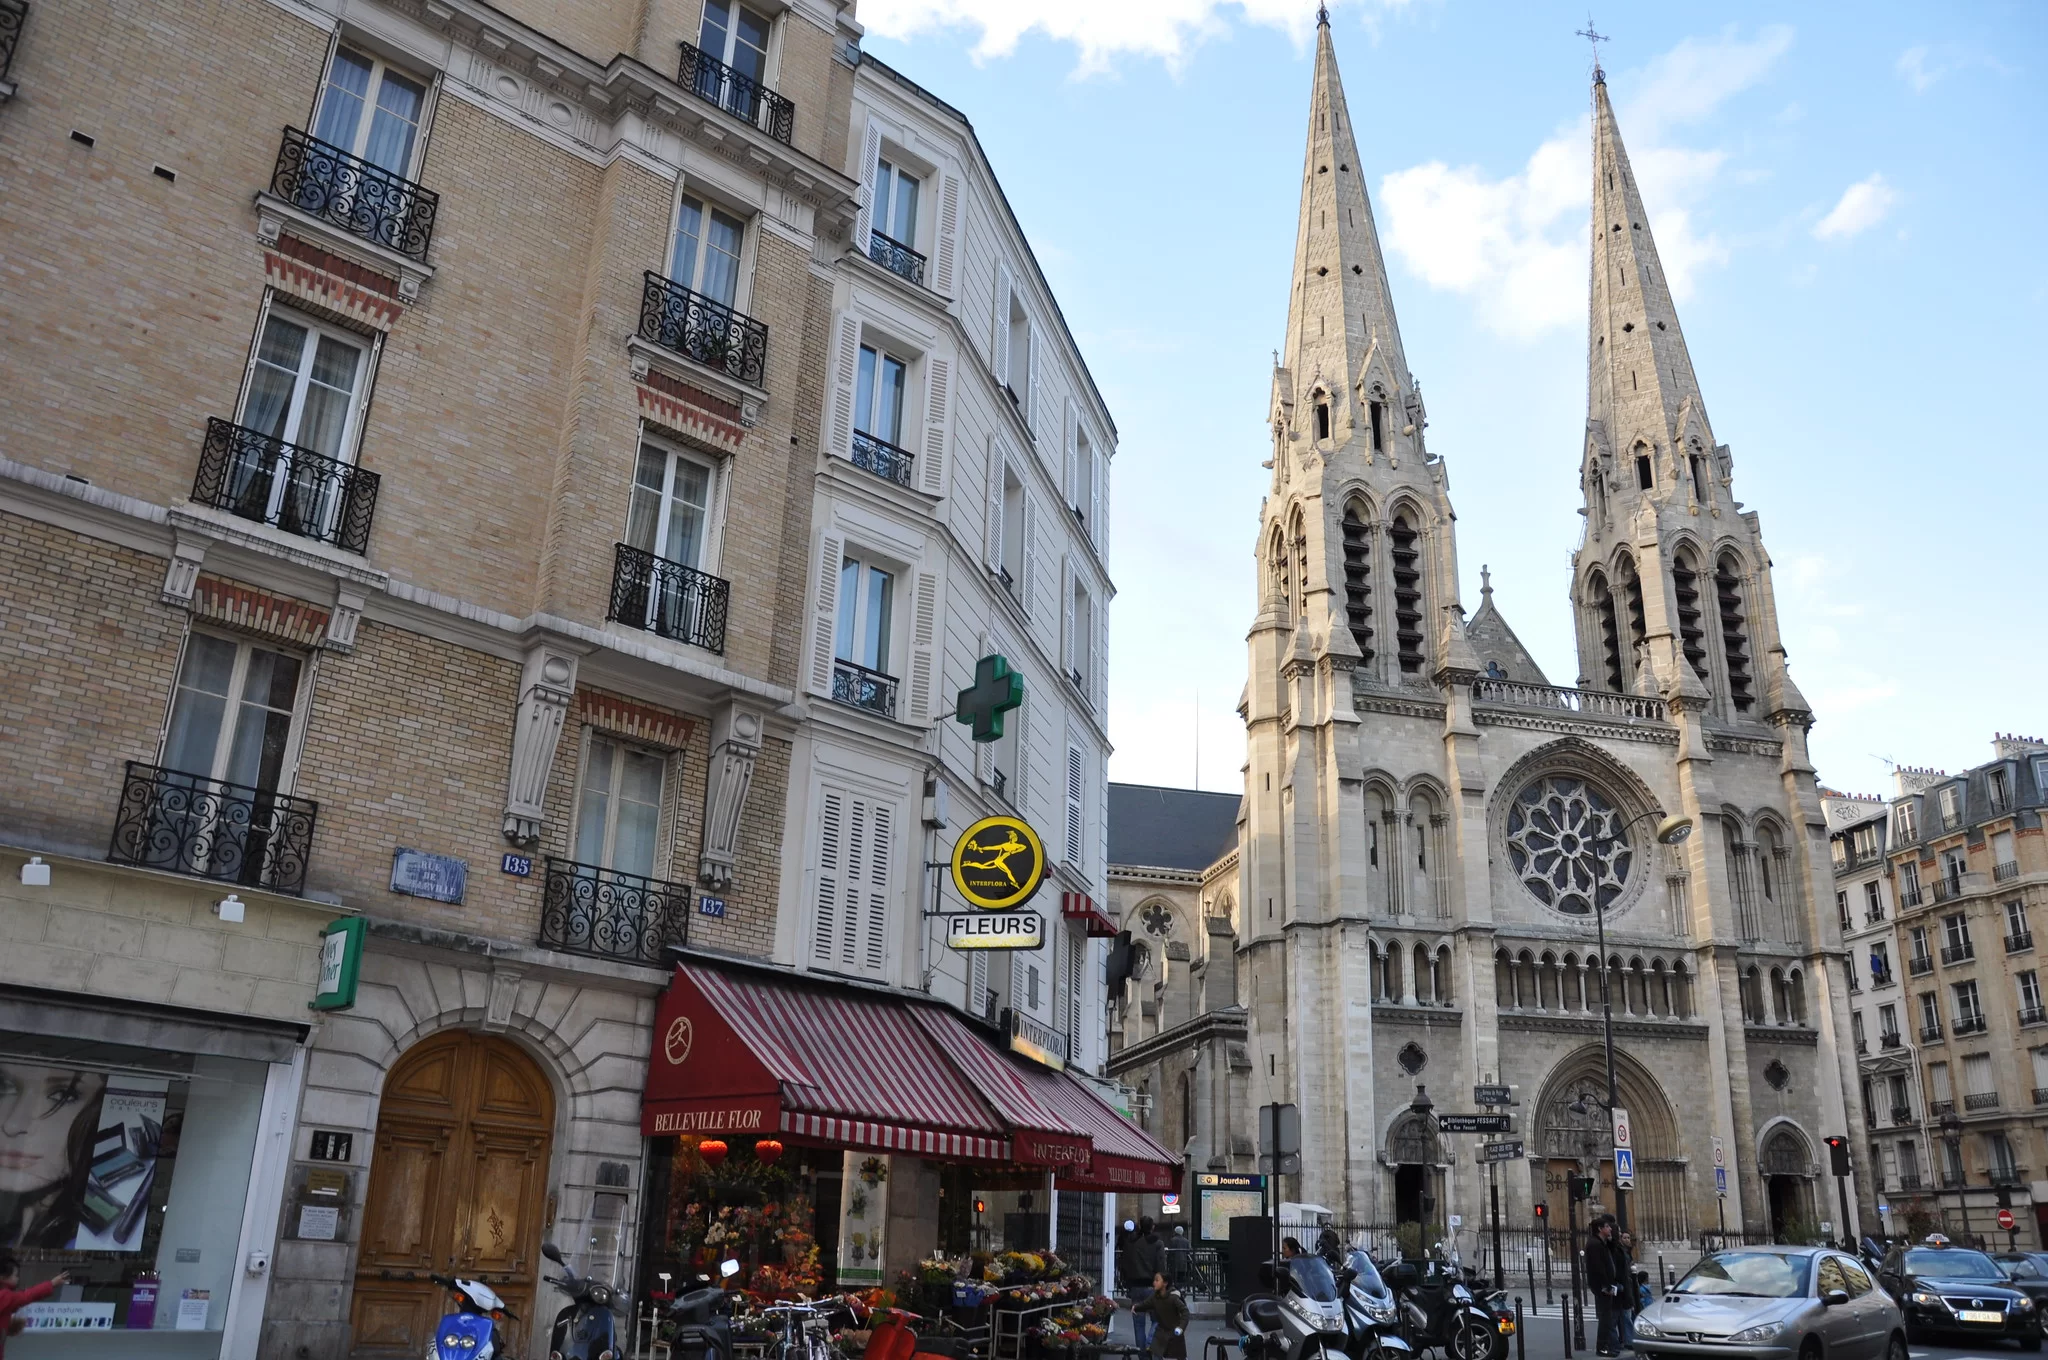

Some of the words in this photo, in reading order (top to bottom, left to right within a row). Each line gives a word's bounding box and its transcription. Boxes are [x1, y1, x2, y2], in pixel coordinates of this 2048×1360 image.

[421, 860, 441, 872] RUE
[504, 855, 528, 875] 135
[702, 897, 723, 915] 137
[952, 916, 1037, 936] FLEURS
[1020, 1019, 1063, 1058] INTERFLORA
[110, 1097, 158, 1109] couleurs
[655, 1110, 725, 1132] BELLEVILLE
[728, 1109, 761, 1129] FLOR
[1220, 1176, 1250, 1185] Jourdain
